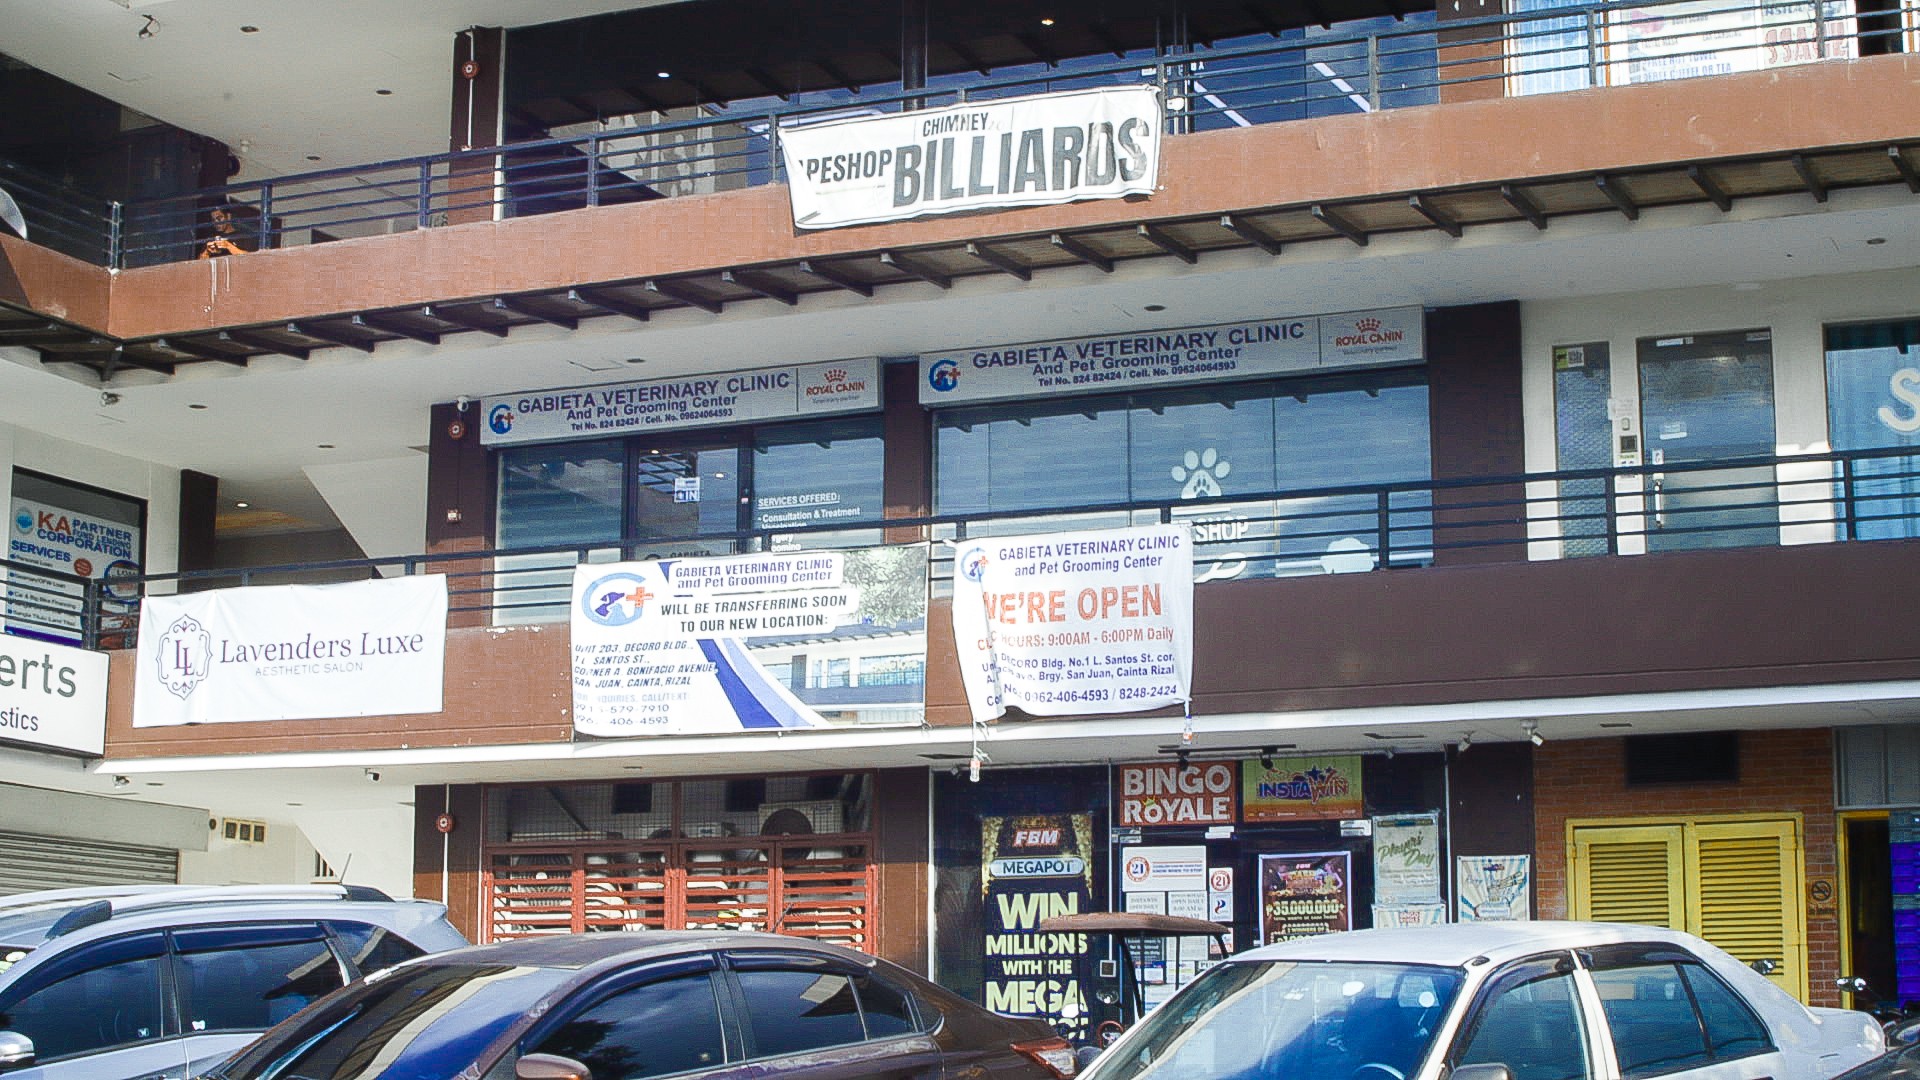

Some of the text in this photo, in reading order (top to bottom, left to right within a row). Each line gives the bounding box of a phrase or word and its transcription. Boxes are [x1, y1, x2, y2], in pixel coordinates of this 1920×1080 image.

[1716, 63, 1732, 73] TEA
[922, 112, 989, 137] CHIMNEY
[799, 117, 1151, 208] PESHOP BILLIARDS
[972, 322, 1305, 368] GABIETA VETERINARY CLINIC
[1335, 330, 1403, 346] ROYAL CANIN
[1032, 347, 1241, 376] And Pet Grooming Center
[806, 382, 865, 397] ROYAL CANIN
[1038, 378, 1051, 387] Tel
[1055, 376, 1070, 385] No.
[517, 373, 790, 414] GABIETA VETERINARY CLINIC
[566, 395, 738, 421] And Pet Grooming Center
[571, 423, 583, 431] Tel
[758, 496, 798, 507] SERVICES
[37, 510, 72, 536] KA
[762, 506, 861, 523] Consultation & Treatment
[72, 518, 132, 541] PARTNER
[1195, 516, 1249, 542] SHOP
[11, 540, 71, 562] SERVICES
[37, 528, 132, 560] CORPORATION
[999, 535, 1180, 561] GABIETA VETERINARY CLINIC
[676, 558, 833, 578] GABIETA VETERINARY CLINIC
[1014, 555, 1163, 576] and Pet Grooming Center
[677, 570, 833, 589] and Pet Grooming Center
[661, 595, 847, 616] WILL BE TRANSFERRING SOON
[1077, 583, 1162, 621] OPEN
[681, 614, 829, 633] TO OUR NEW LOCATION:
[220, 632, 424, 663] Lavenders Luxe
[624, 642, 661, 652] DECORO
[1001, 634, 1045, 648] HOURS:
[1048, 631, 1090, 646] 9:00AM
[1101, 628, 1143, 643] 6:00PM
[1147, 627, 1174, 643] Daily
[255, 661, 363, 676] AESTHETIC SALON
[593, 655, 631, 665] SANTOS
[1041, 658, 1066, 671] Bldg.
[1069, 656, 1090, 668] No.1
[1093, 656, 1102, 666] L.
[1105, 654, 1138, 665] Santos
[1140, 653, 1154, 663] St.
[1157, 653, 1175, 662] cor.
[627, 665, 675, 676] BONIFACIO
[1039, 671, 1063, 683] Brgy.
[1067, 669, 1085, 680] San
[1087, 667, 1114, 679] Juan,
[1116, 665, 1148, 676] Cainta
[1151, 664, 1174, 675] Rizal
[665, 676, 691, 686] RIZAL
[574, 691, 588, 701] OR
[1119, 685, 1177, 700] 8248-2424
[0, 707, 39, 731] stics
[1123, 765, 1231, 795] BINGO
[1258, 769, 1349, 805] INSTAWIN
[1124, 797, 1231, 824] ROYALE
[1014, 830, 1060, 846] FBM
[1002, 859, 1074, 874] MEGAPOT
[1404, 848, 1435, 867] Day
[1131, 863, 1144, 874] 21
[1215, 876, 1226, 887] 21
[996, 892, 1079, 930] WIN
[986, 933, 1088, 956] MILLIONS
[1002, 960, 1073, 975] WITH THE
[986, 980, 1089, 1013] MEGA
